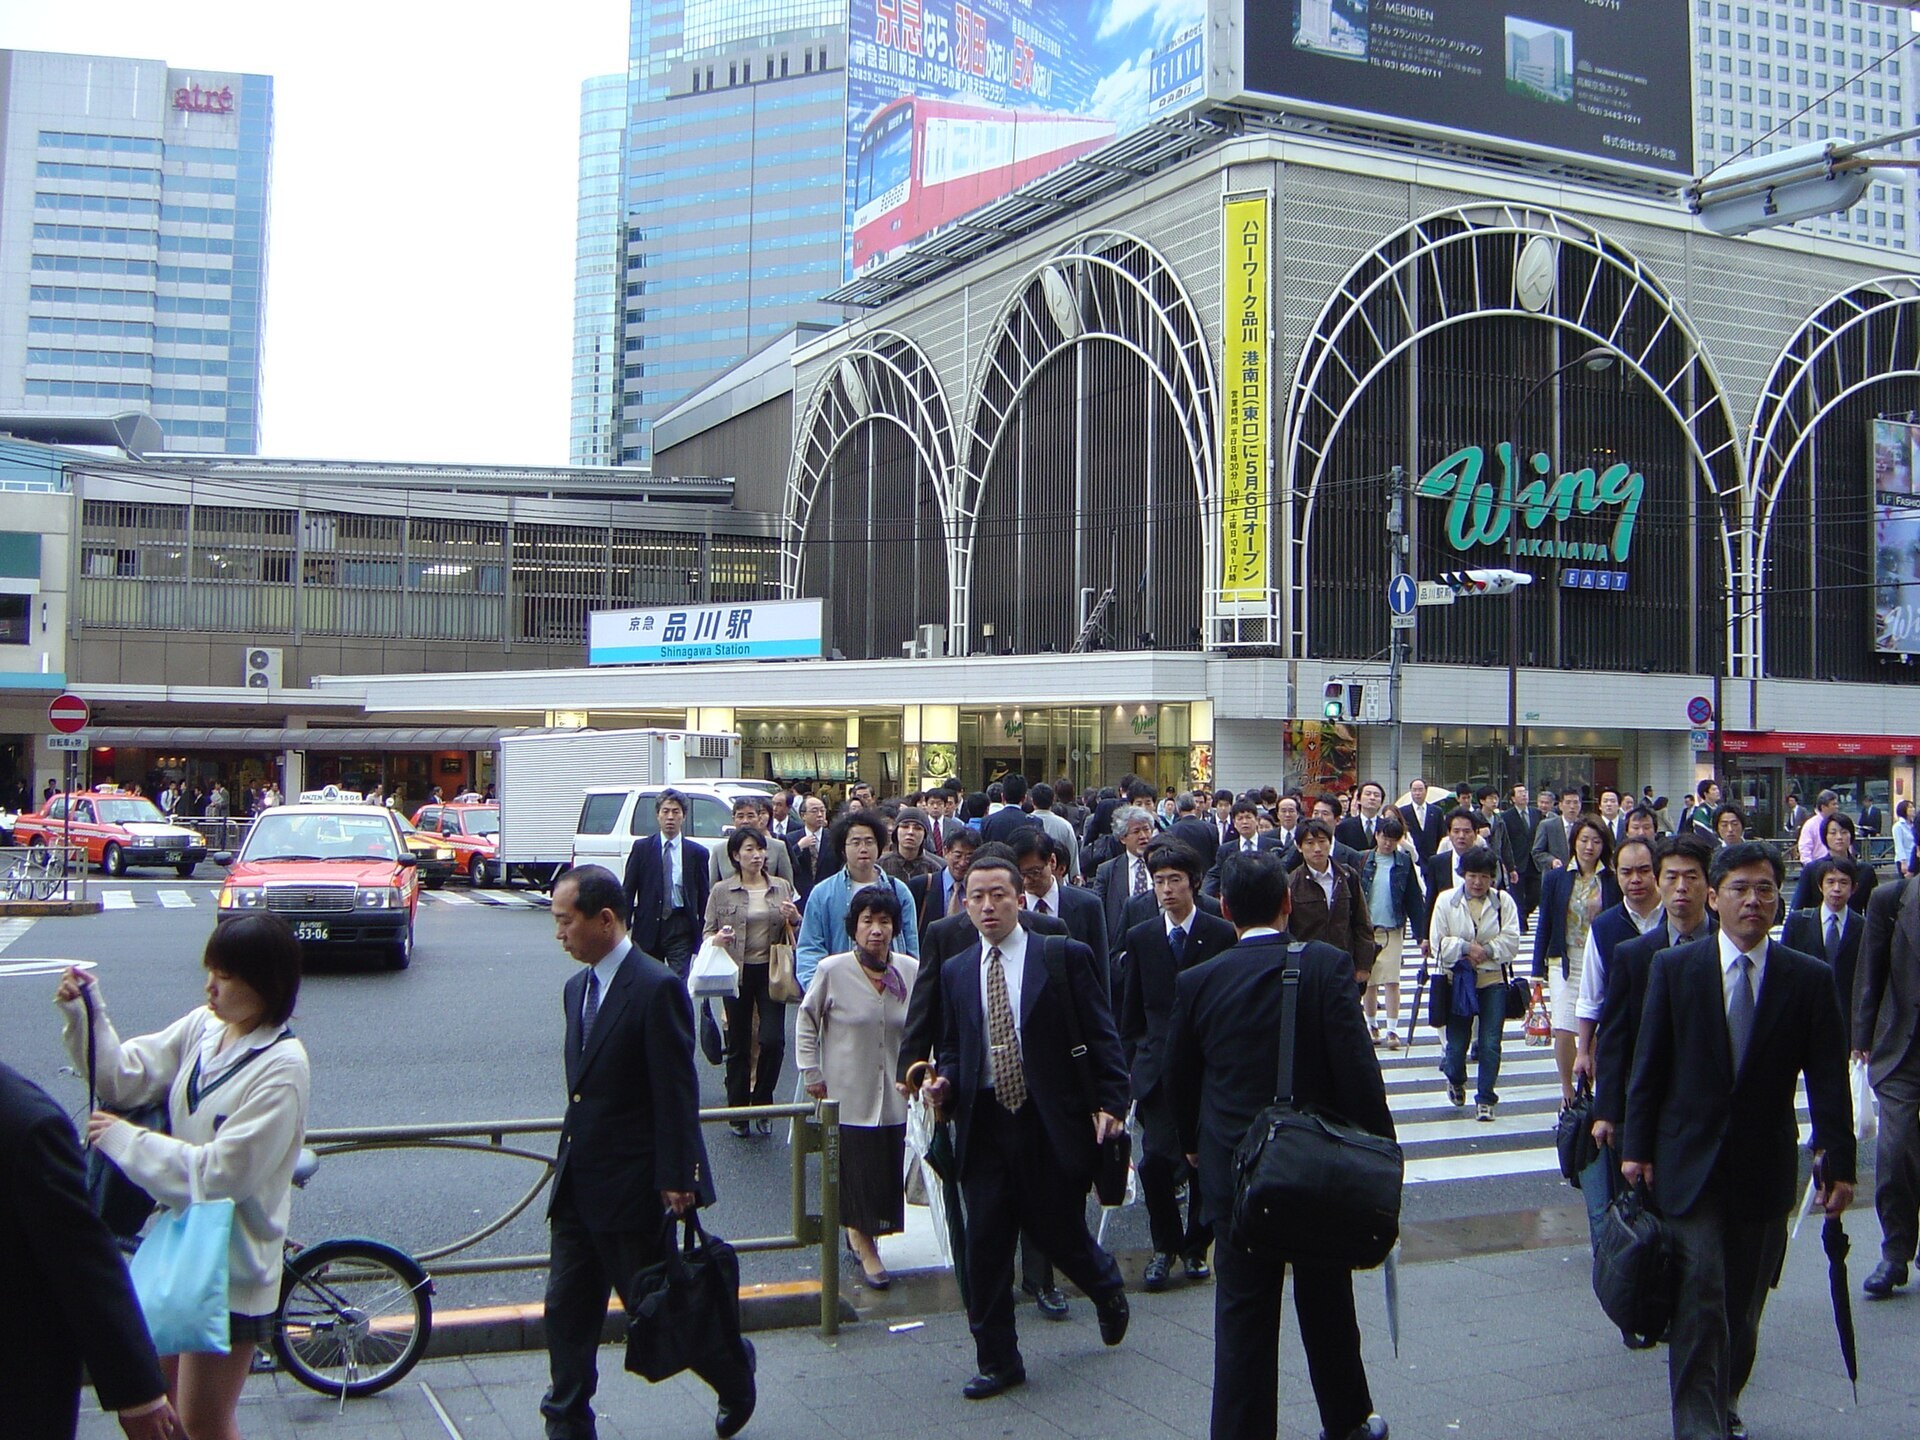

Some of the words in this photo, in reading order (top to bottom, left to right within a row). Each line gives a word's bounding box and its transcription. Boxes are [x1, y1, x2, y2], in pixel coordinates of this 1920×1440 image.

[1151, 43, 1201, 95] KEIKYU
[174, 83, 234, 112] atré
[1242, 219, 1259, 343] ハローワーク品川
[1414, 441, 1645, 562] Wing
[1567, 572, 1623, 588] EAST
[628, 615, 655, 632] 京急
[661, 608, 753, 643] 品川駅
[660, 645, 712, 660] Shinagawa
[714, 643, 751, 656] Station
